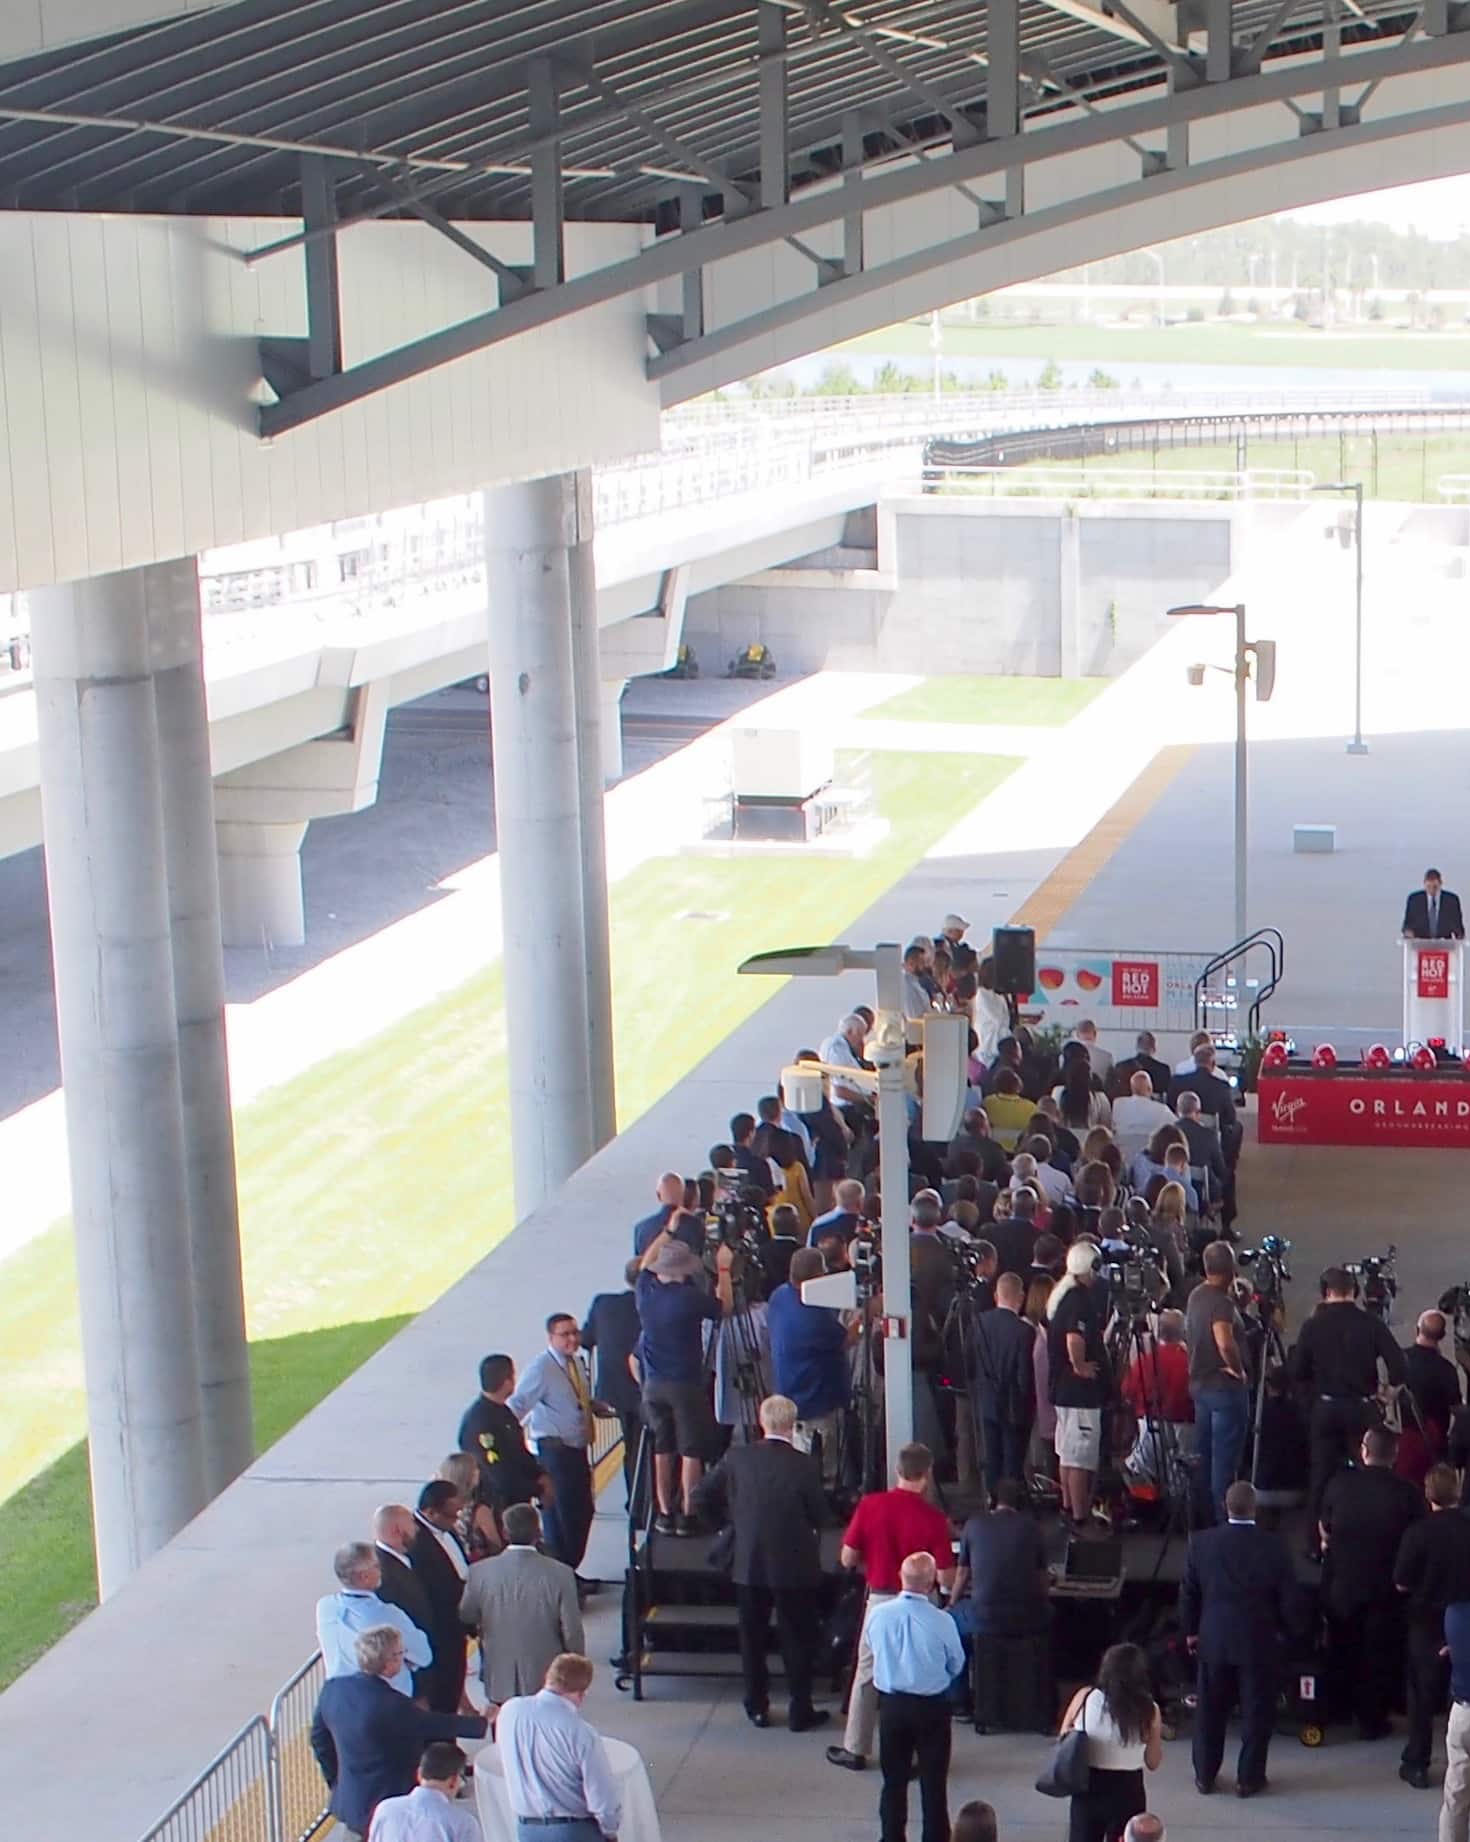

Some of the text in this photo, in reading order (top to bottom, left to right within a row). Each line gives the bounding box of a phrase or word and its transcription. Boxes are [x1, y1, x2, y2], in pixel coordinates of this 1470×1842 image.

[1122, 972, 1149, 983] RED
[1421, 969, 1443, 977] HOT
[1122, 983, 1148, 994] HOT
[1272, 1091, 1306, 1122] Virgin
